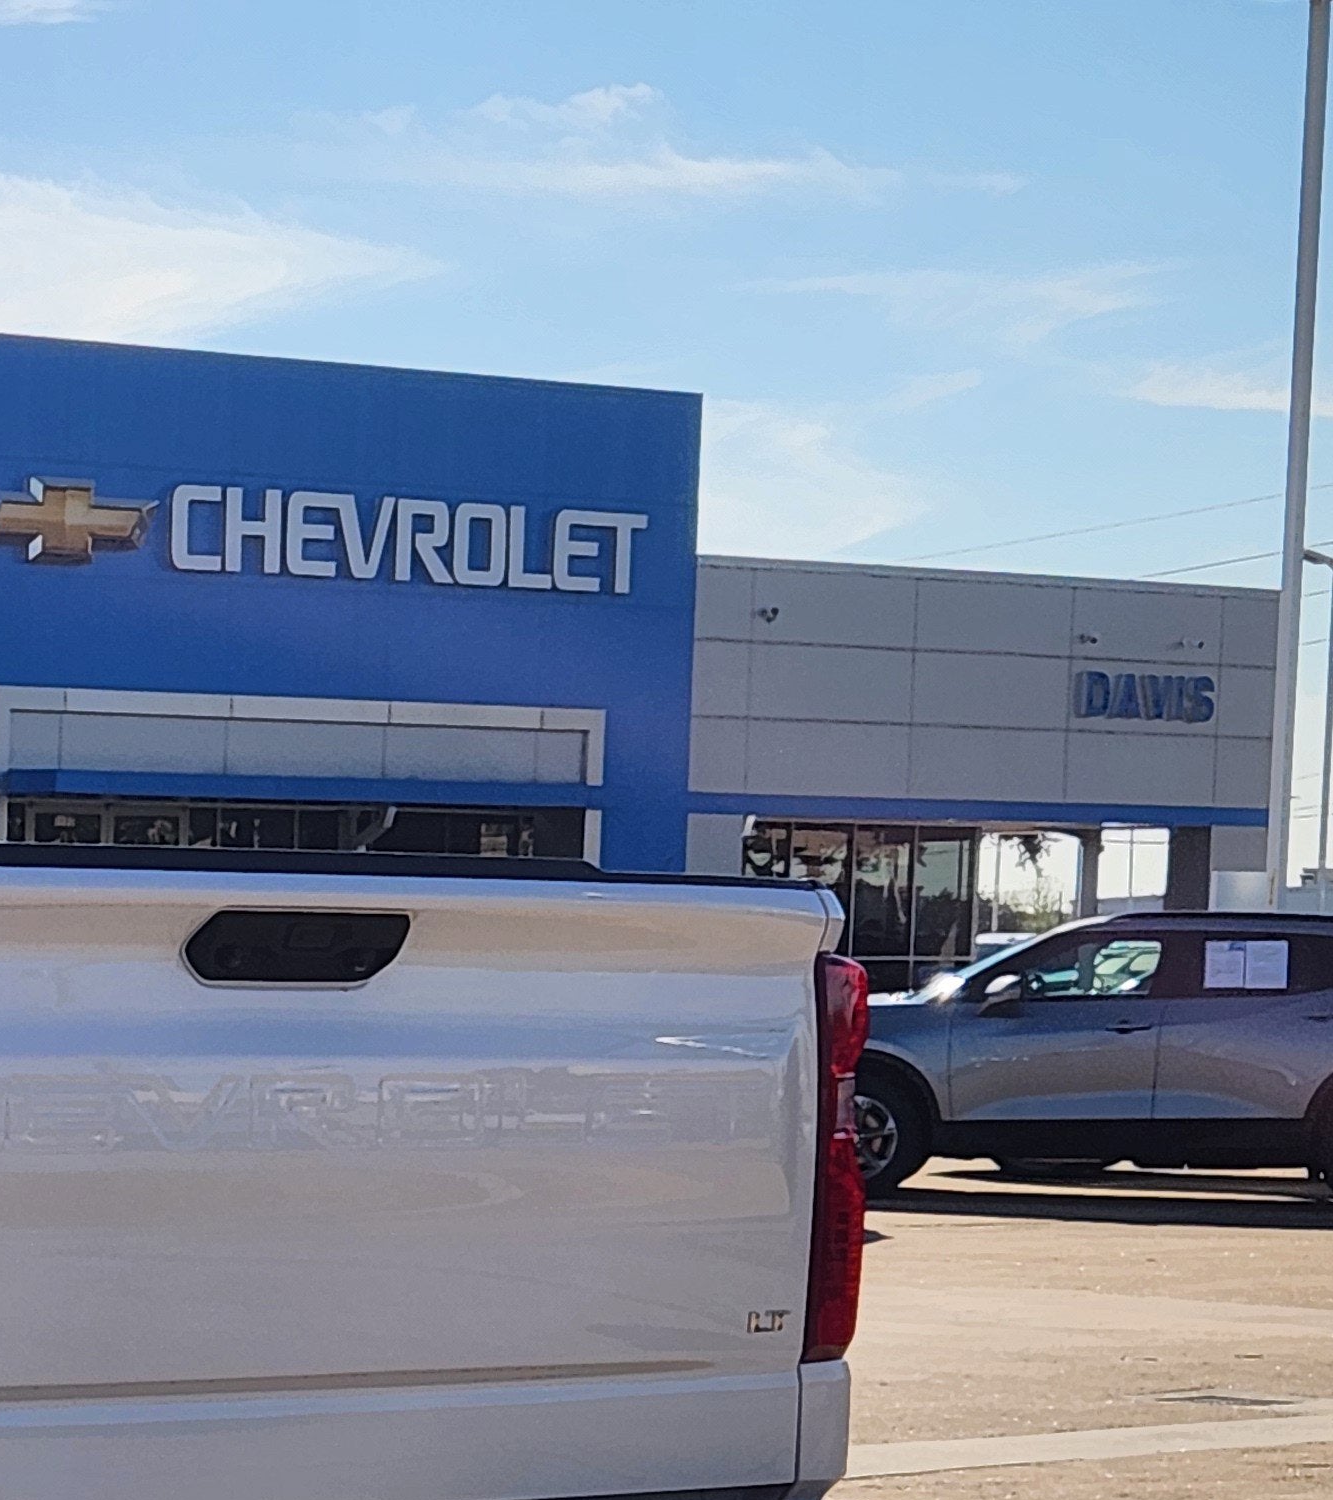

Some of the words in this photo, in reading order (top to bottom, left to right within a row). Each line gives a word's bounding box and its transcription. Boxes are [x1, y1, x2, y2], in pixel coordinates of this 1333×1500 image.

[169, 483, 649, 595] CHEVROLET
[1073, 670, 1215, 724] DAVIS
[746, 1309, 792, 1334] LT
